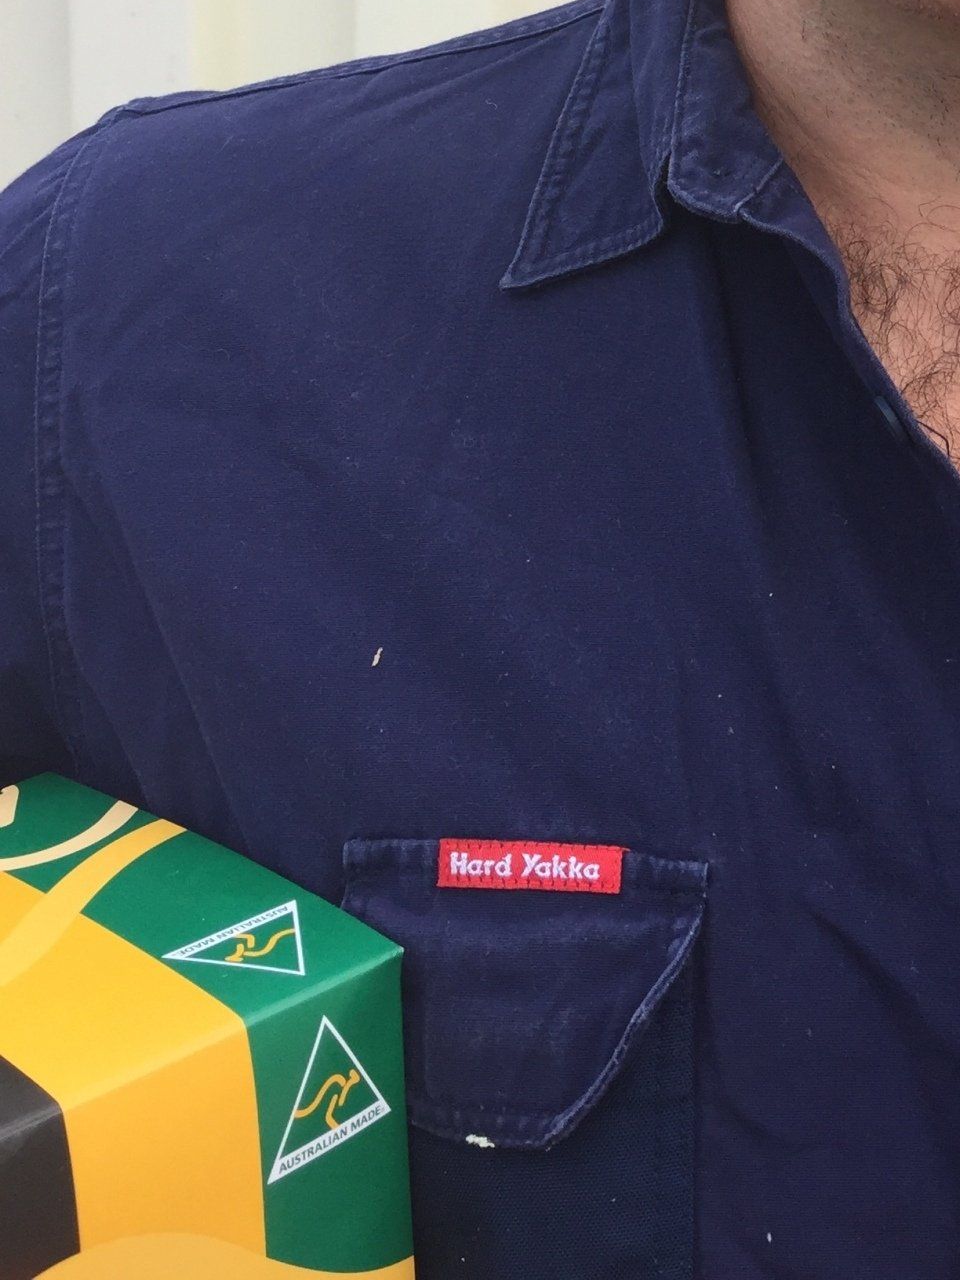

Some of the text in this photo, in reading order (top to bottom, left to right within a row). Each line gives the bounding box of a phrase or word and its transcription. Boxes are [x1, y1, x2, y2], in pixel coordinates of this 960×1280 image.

[449, 851, 600, 880] Hard Yakka
[216, 905, 289, 940] AUSTRALIAN
[278, 1105, 382, 1175] AUSTRALIAN MADE
